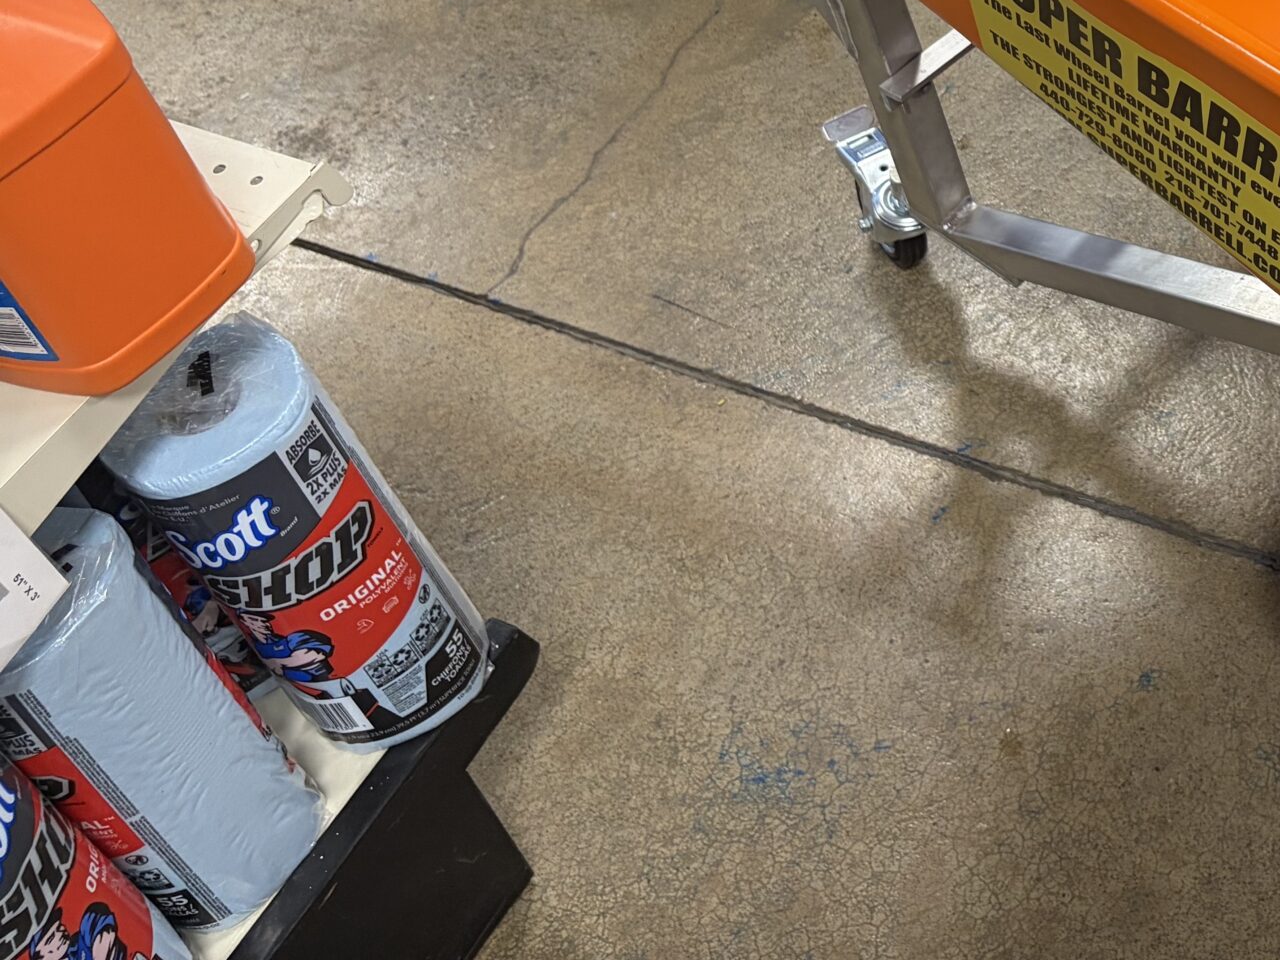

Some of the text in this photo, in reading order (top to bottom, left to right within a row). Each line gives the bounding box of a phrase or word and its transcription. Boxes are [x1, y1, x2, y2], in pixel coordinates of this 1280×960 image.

[989, 29, 1020, 61] THE
[1022, 53, 1117, 128] STRONGEST
[1120, 122, 1155, 155] AND
[1158, 149, 1239, 214] LIGHTEST
[1242, 209, 1267, 235] ON
[1015, 12, 1052, 48] Last
[1053, 38, 1110, 90] Wheel
[1113, 81, 1170, 131] Barrel
[1174, 125, 1207, 158] you
[1211, 152, 1246, 185] will
[1068, 67, 1242, 198] LIFETIME WARRANTY
[1039, 82, 1280, 262] 440-729-8080 216-701-7448
[285, 420, 321, 465] ABSORBE
[306, 451, 342, 496] 2X PLUS
[166, 497, 276, 569] Scott
[315, 490, 330, 504] 2X
[205, 499, 374, 611] SHOP
[320, 548, 403, 622] ORIGINAL
[431, 648, 467, 687] CHIFFONS
[444, 628, 464, 658] 55
[159, 894, 187, 907] 55
